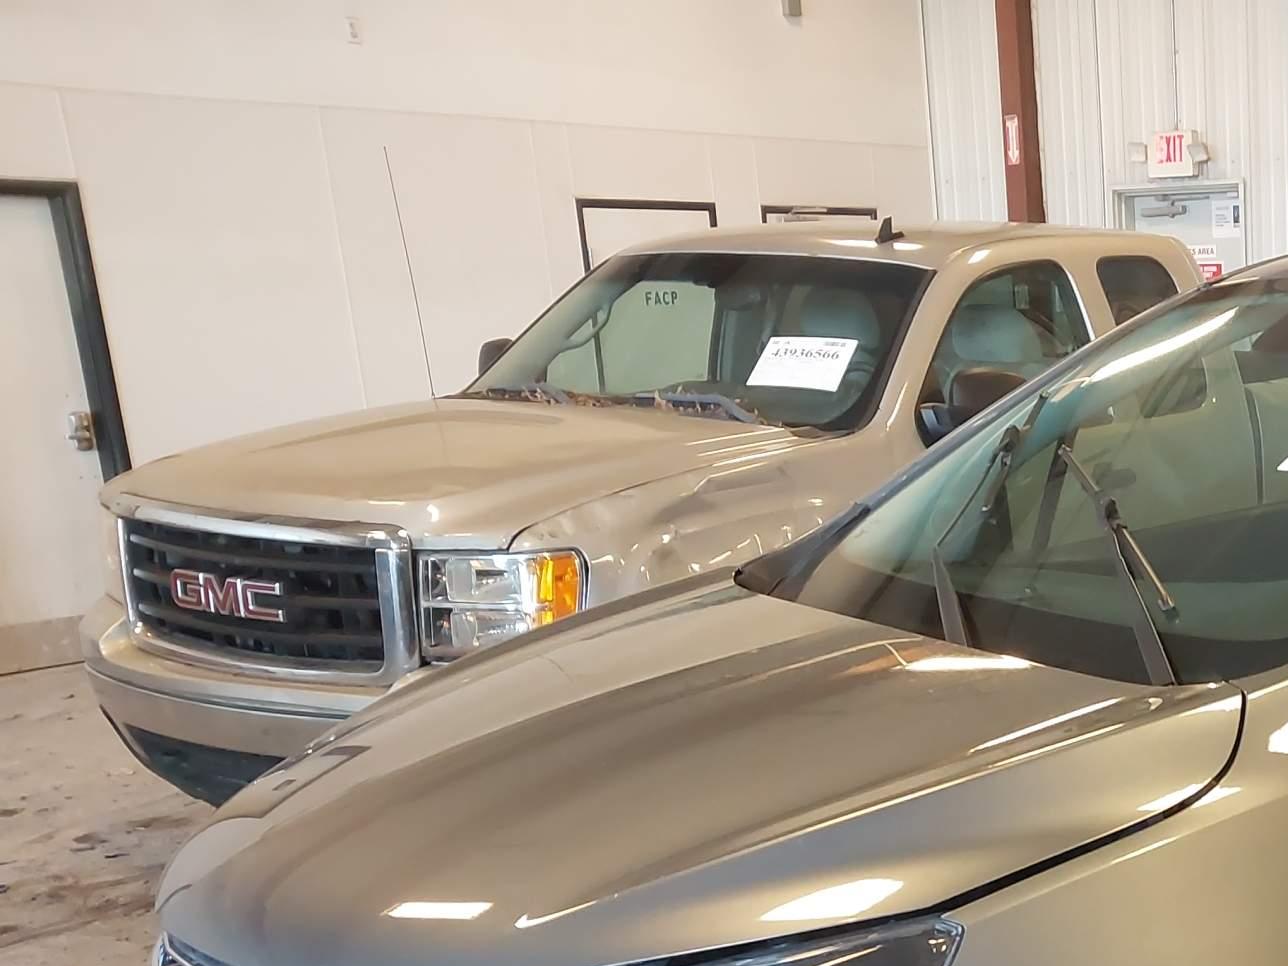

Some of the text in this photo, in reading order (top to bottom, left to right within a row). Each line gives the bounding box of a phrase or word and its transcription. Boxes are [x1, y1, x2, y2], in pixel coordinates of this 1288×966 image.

[1156, 134, 1184, 164] EXIT
[645, 291, 678, 306] FACP
[170, 568, 285, 622] GMC
